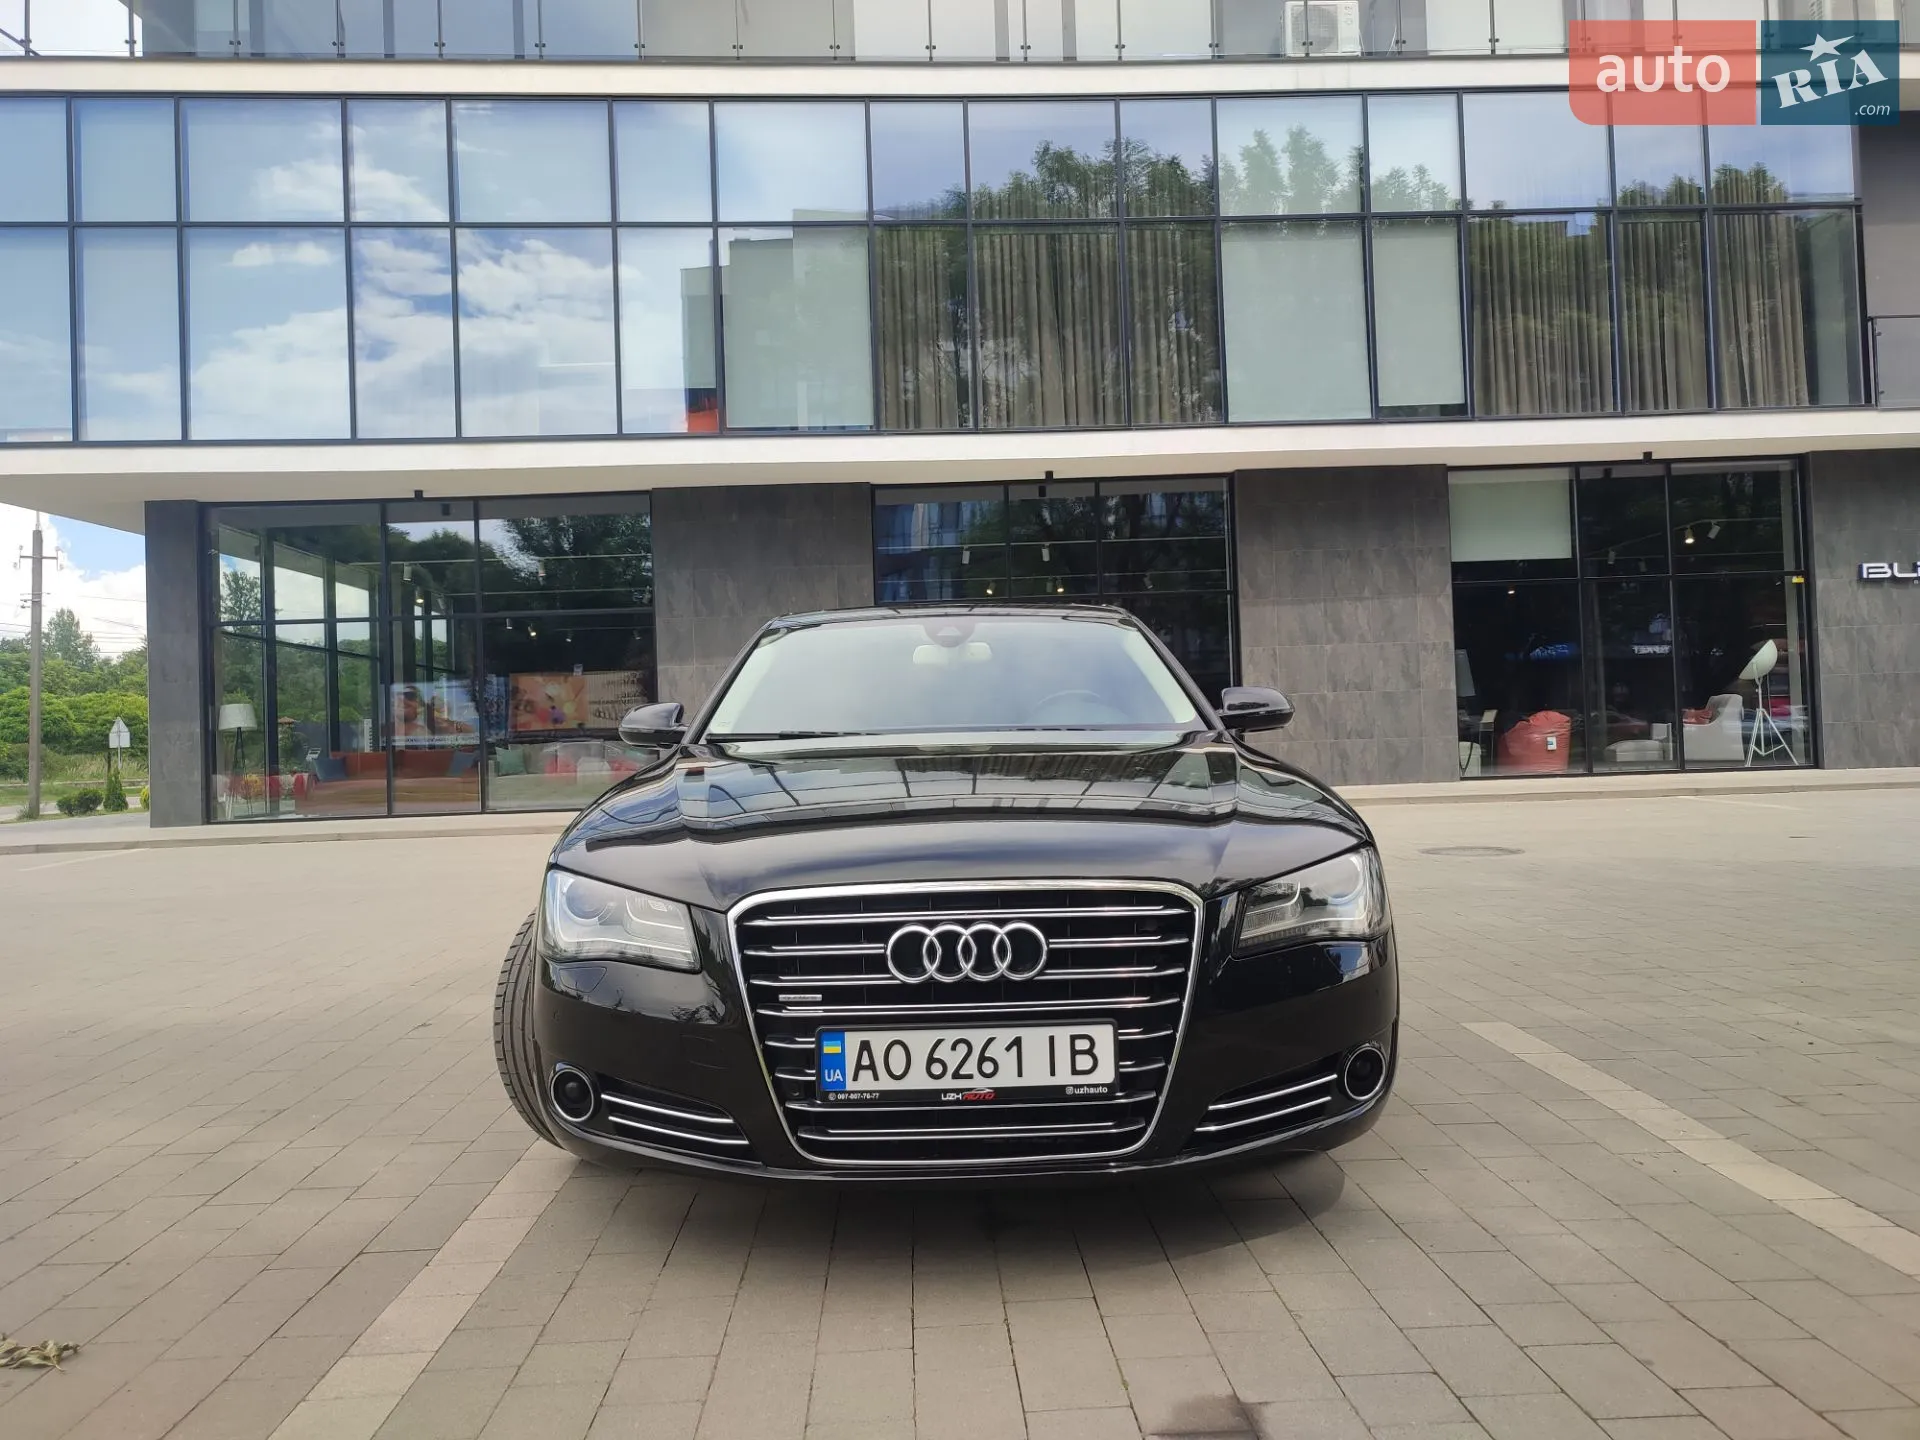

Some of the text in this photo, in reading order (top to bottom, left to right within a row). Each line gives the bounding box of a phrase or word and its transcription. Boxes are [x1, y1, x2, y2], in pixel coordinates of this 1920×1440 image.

[1862, 561, 1920, 579] BL
[851, 1033, 1099, 1082] AO 6261 IB
[824, 1069, 844, 1082] UA
